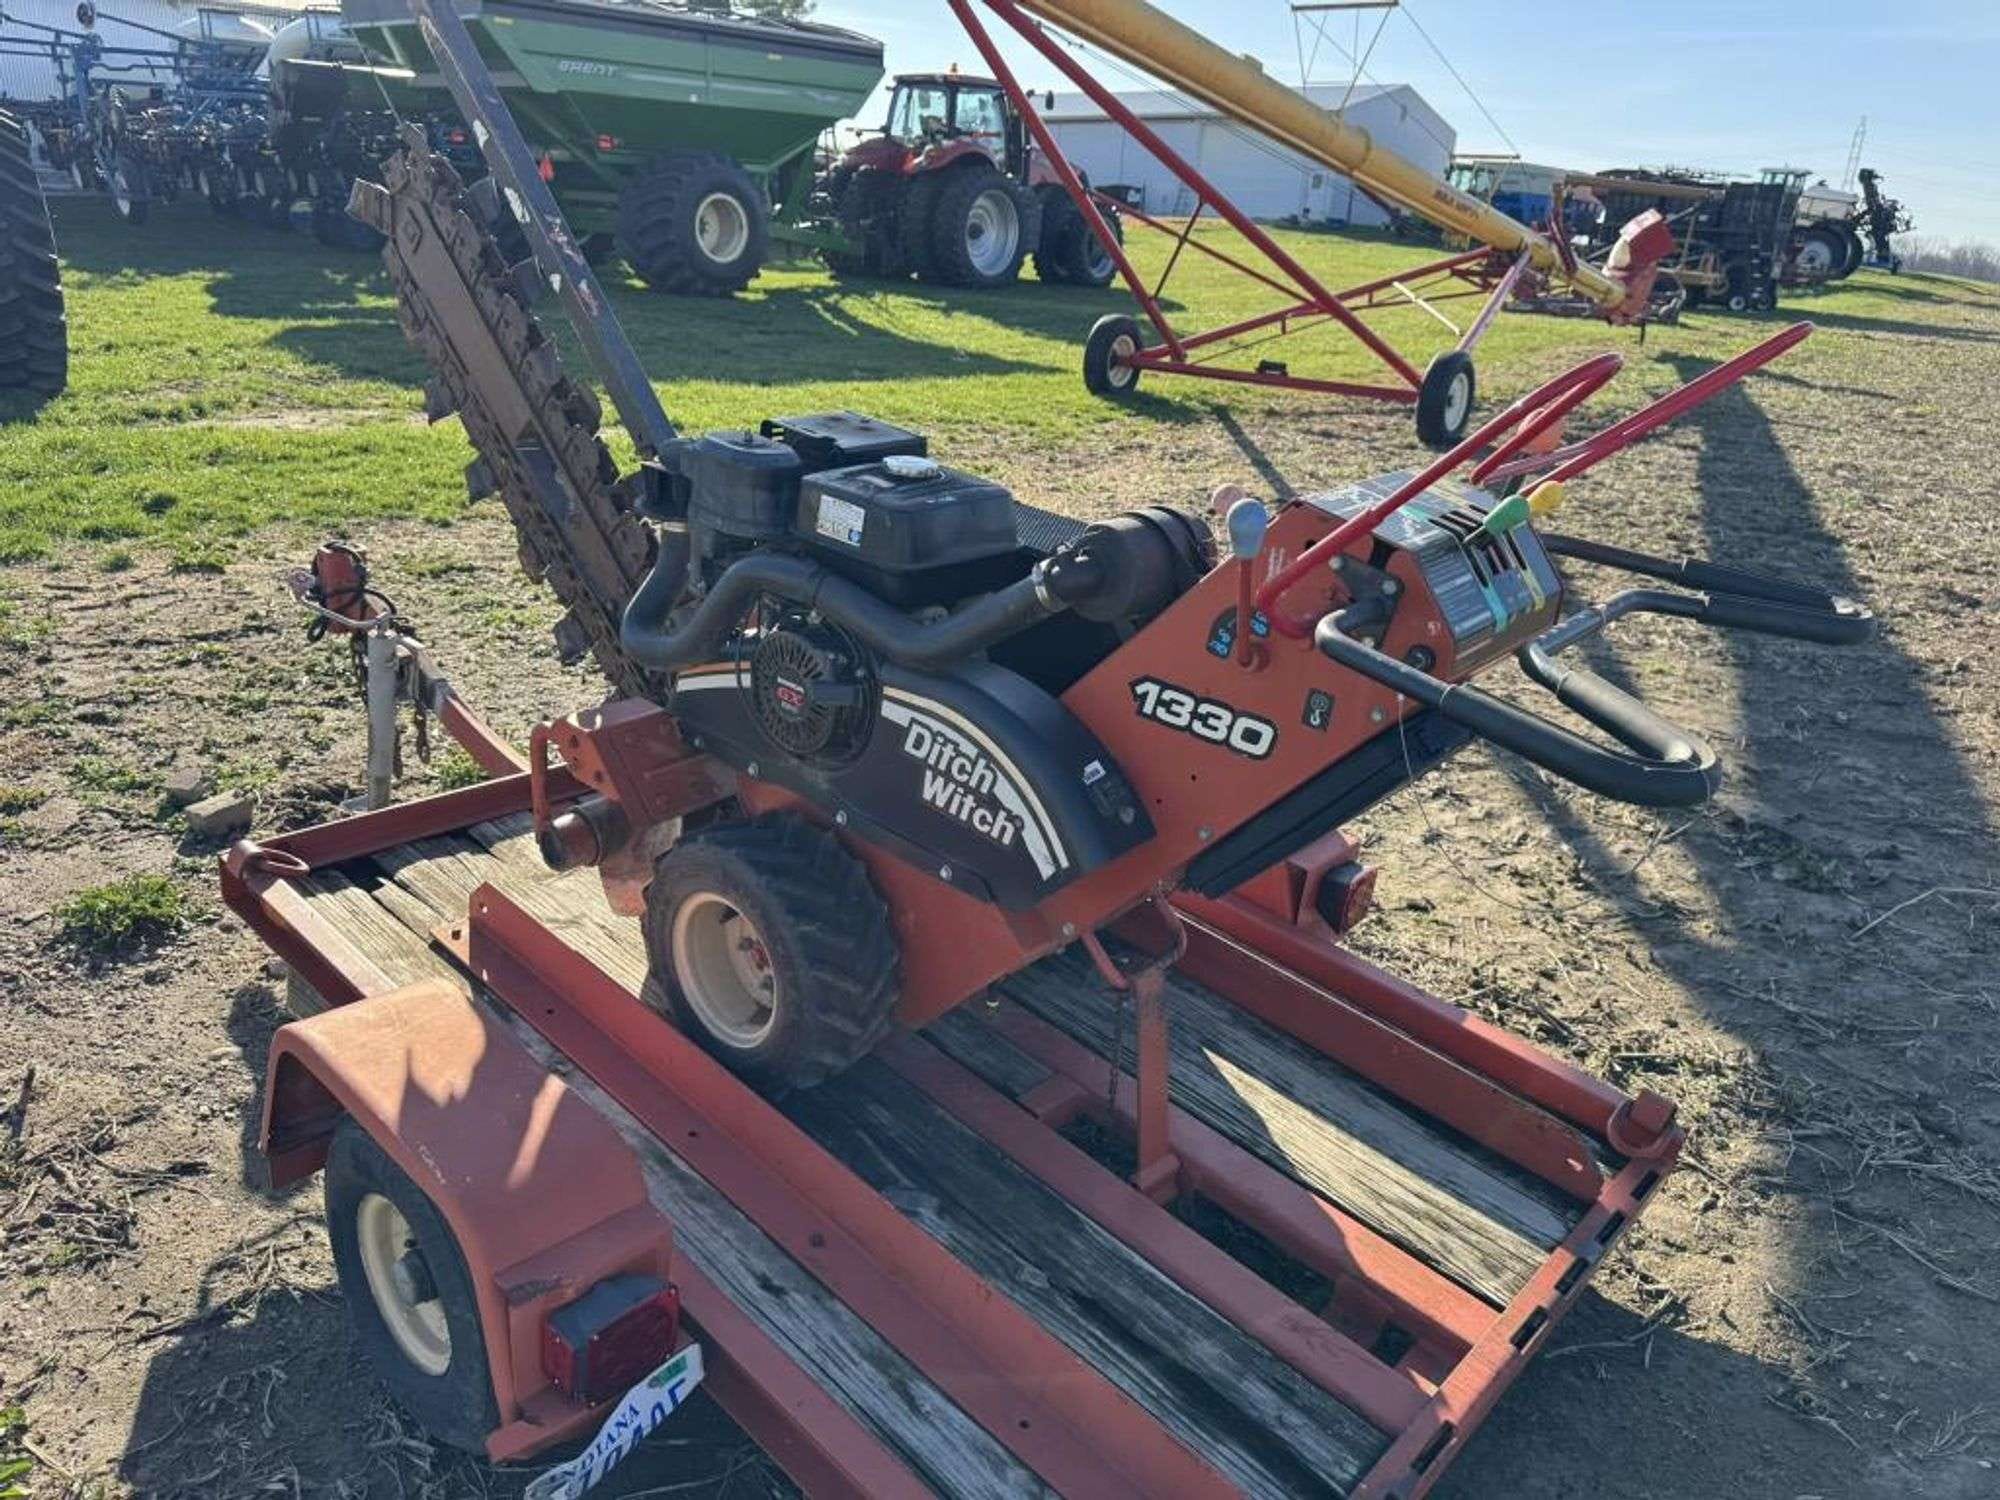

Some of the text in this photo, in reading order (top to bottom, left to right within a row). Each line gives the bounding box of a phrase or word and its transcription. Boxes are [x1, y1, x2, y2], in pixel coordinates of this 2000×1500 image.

[1134, 680, 1275, 756] 1330
[904, 721, 995, 794] Ditch
[922, 769, 1016, 845] Witch
[549, 1404, 640, 1483] NDIANA
